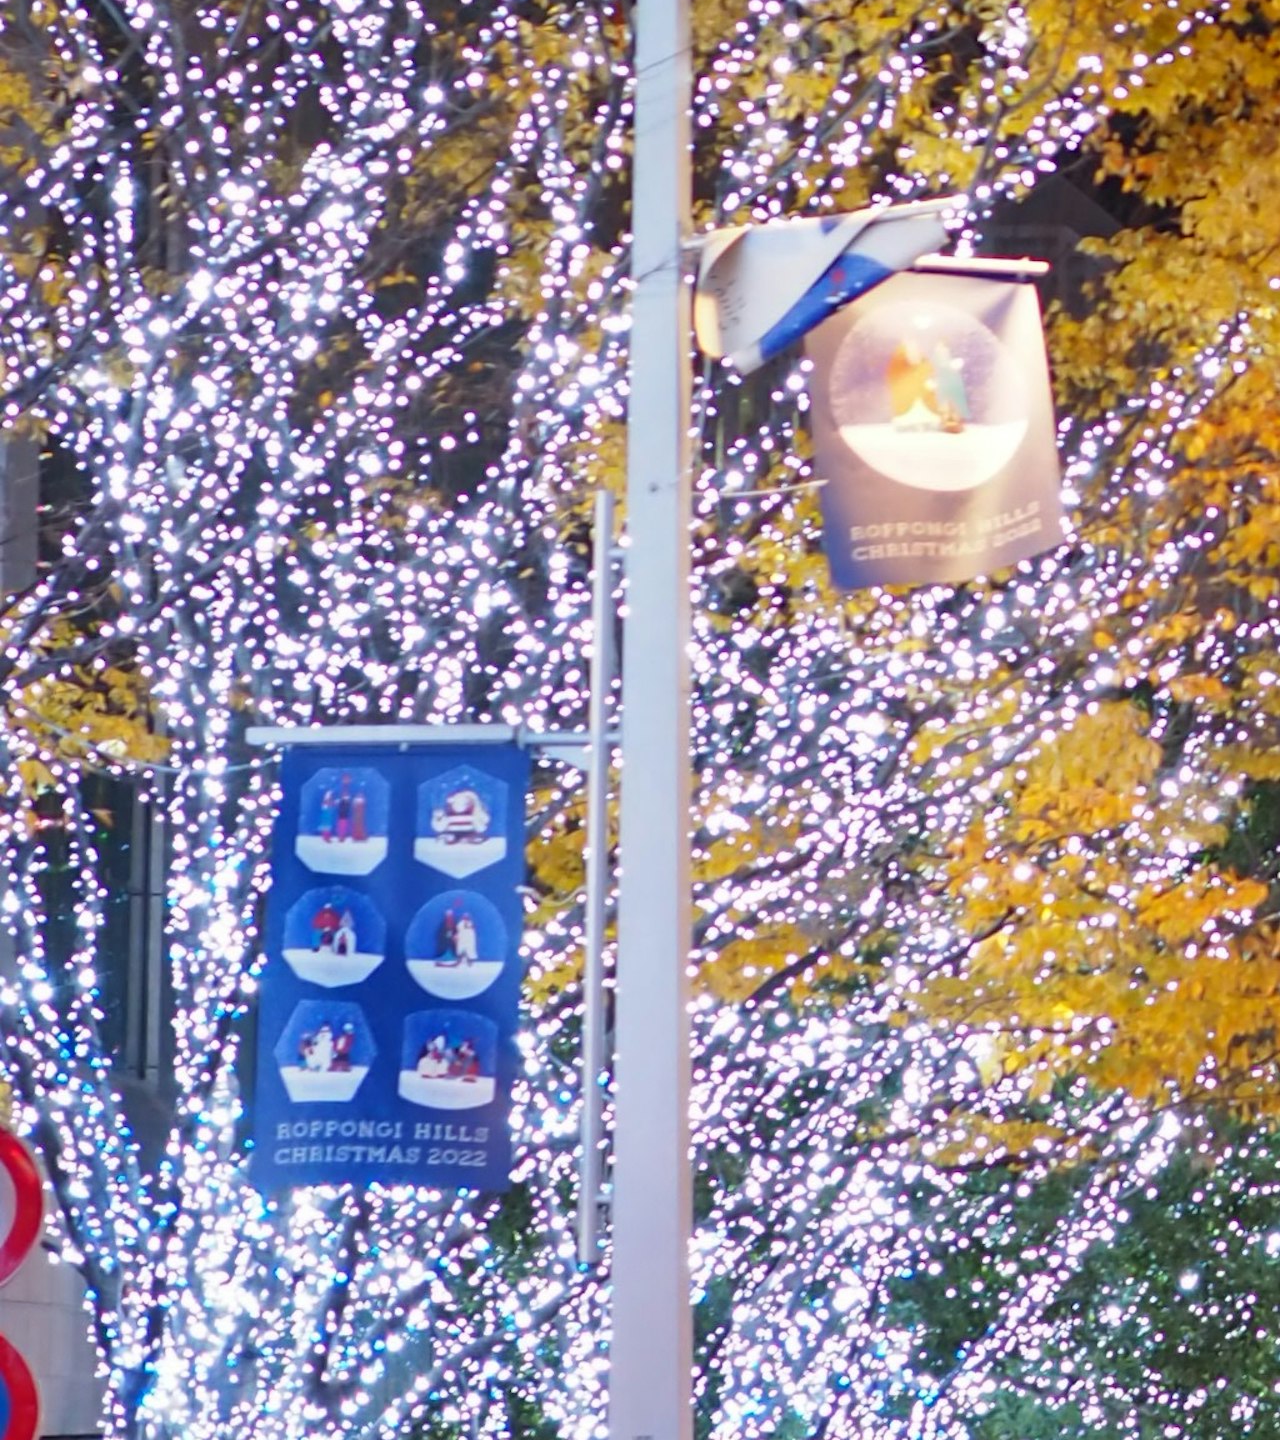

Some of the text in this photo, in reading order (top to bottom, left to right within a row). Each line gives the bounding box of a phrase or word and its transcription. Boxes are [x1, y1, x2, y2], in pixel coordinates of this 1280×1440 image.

[850, 521, 967, 541] ROPPONGI
[852, 538, 986, 560] CHRISTMAS
[276, 1120, 490, 1143] ROPPONGI HILLS
[273, 1145, 487, 1167] CHRISTMAS 2022
